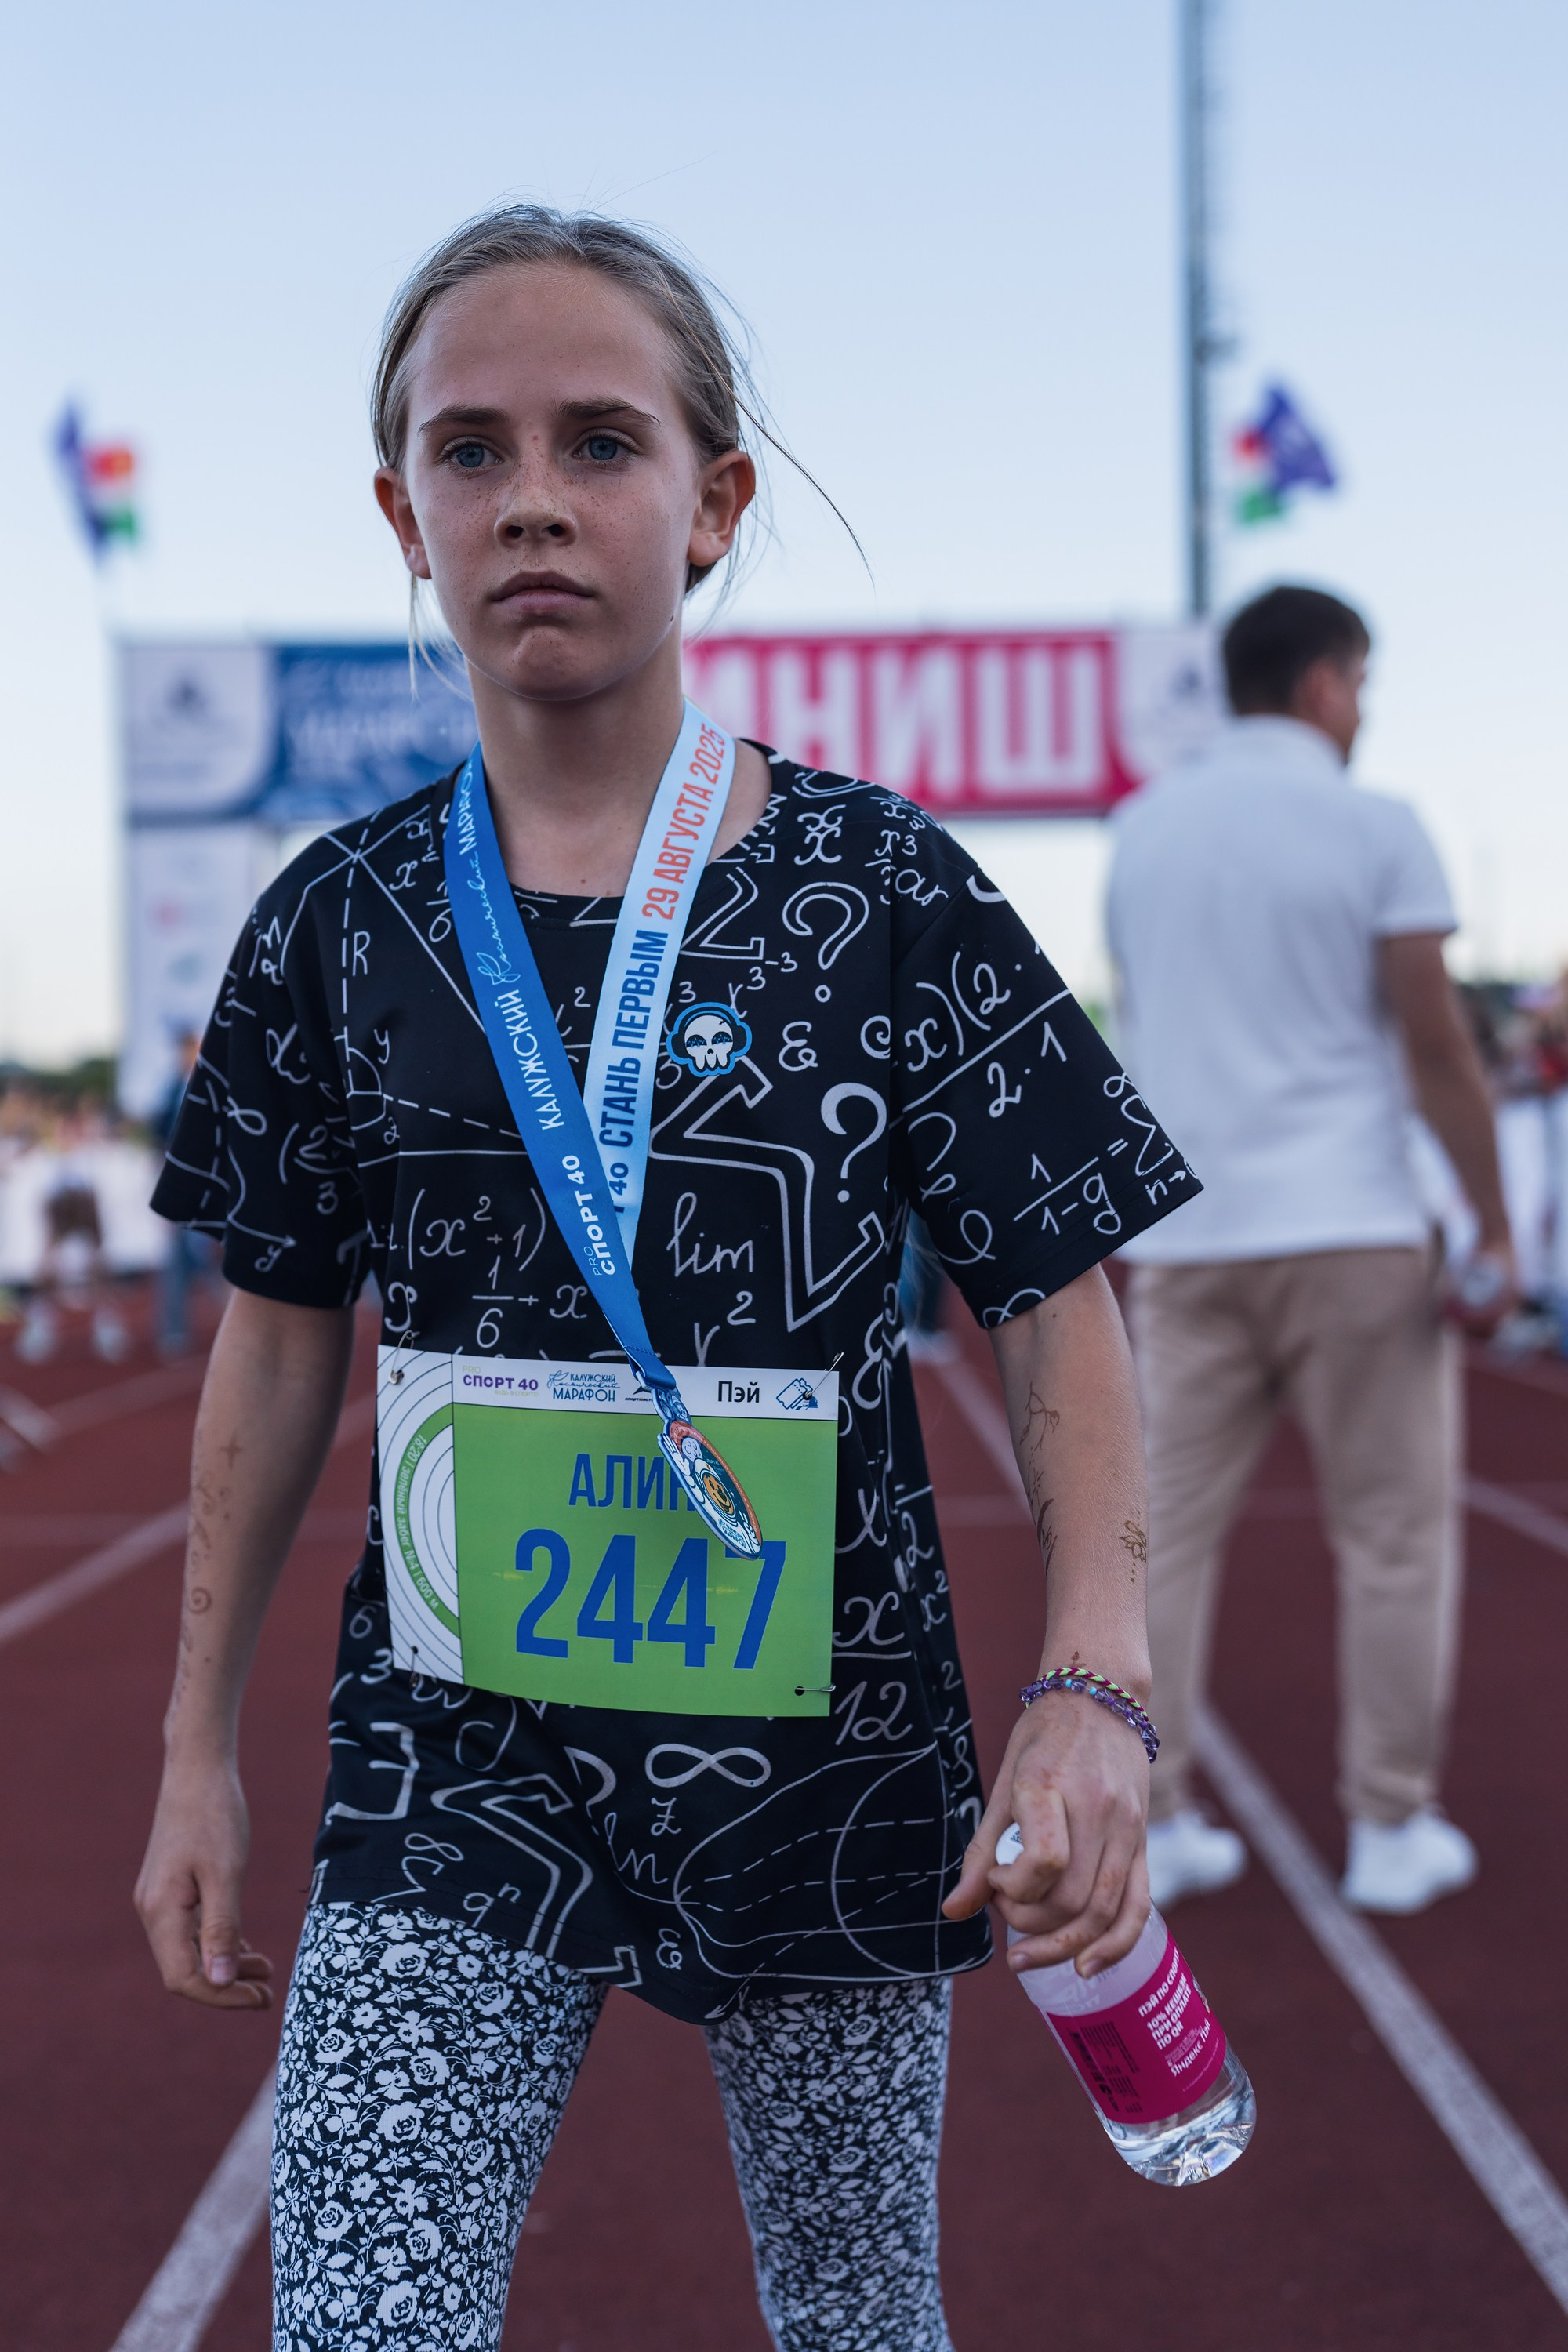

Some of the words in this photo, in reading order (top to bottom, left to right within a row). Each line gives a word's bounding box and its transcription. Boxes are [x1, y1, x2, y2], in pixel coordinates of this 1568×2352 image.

[681, 644, 1099, 793] ИНИШ
[689, 723, 728, 785] 2025
[653, 782, 714, 884] АВГУСТА
[641, 887, 680, 920] 29
[612, 929, 669, 1051] ПЕРВЫМ
[494, 989, 565, 1130] КАЛУЖСКИЙ
[598, 1058, 641, 1148] СТАНЬ
[562, 1155, 585, 1185] 40
[575, 1190, 615, 1276] СПОРТ
[667, 1192, 754, 1278] lim
[583, 1246, 603, 1276] PRO
[463, 1365, 481, 1374] PRO
[463, 1374, 515, 1391] СПОРТ
[518, 1378, 539, 1391] 40
[570, 1373, 616, 1383] КАЛУЖСКИЙ
[717, 1381, 760, 1403] Пэй
[553, 1387, 615, 1402] МАРАФОН
[407, 1433, 427, 1463] 18:20
[568, 1453, 695, 1512] АЛИН
[397, 1517, 410, 1547] забег
[416, 1578, 433, 1599] 600
[515, 1528, 786, 1670] 2447
[1138, 1991, 1159, 2017] ПЭЙ
[1156, 1981, 1169, 1999] ПО
[1146, 2011, 1167, 2031] 10%
[1164, 1973, 1187, 2016] КЕШБЭК
[1152, 2020, 1173, 2041] ПРИ
[1171, 1983, 1192, 2021] ОПЛАТЕ
[1156, 2033, 1171, 2050] ПО
[1171, 2020, 1184, 2038] QR
[1171, 2040, 1203, 2077] Яндекс
[1200, 2017, 1210, 2043] Пэй
